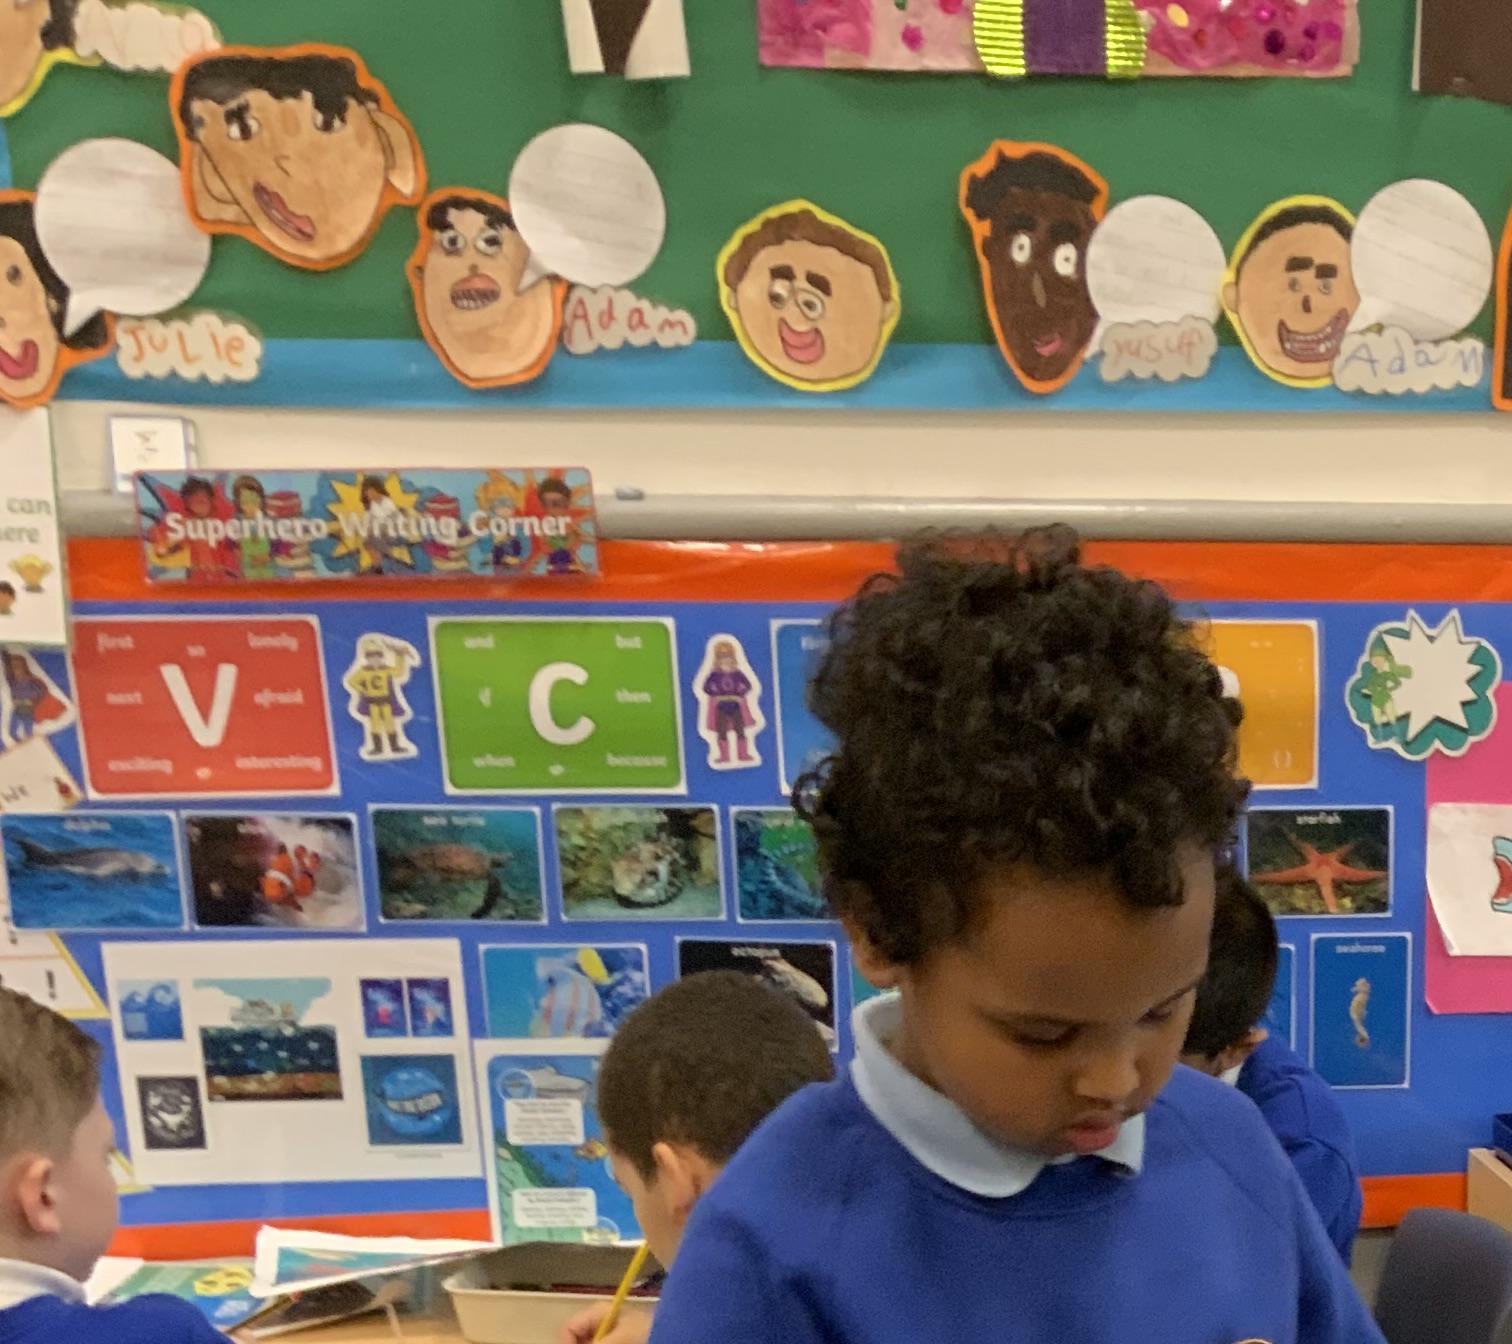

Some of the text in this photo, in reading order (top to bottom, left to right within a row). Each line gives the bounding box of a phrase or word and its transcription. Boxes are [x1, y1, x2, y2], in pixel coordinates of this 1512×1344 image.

[0, 526, 40, 543] ere
[166, 511, 571, 547] Superhero Writing Corner
[159, 662, 238, 748] V
[528, 661, 596, 746] C
